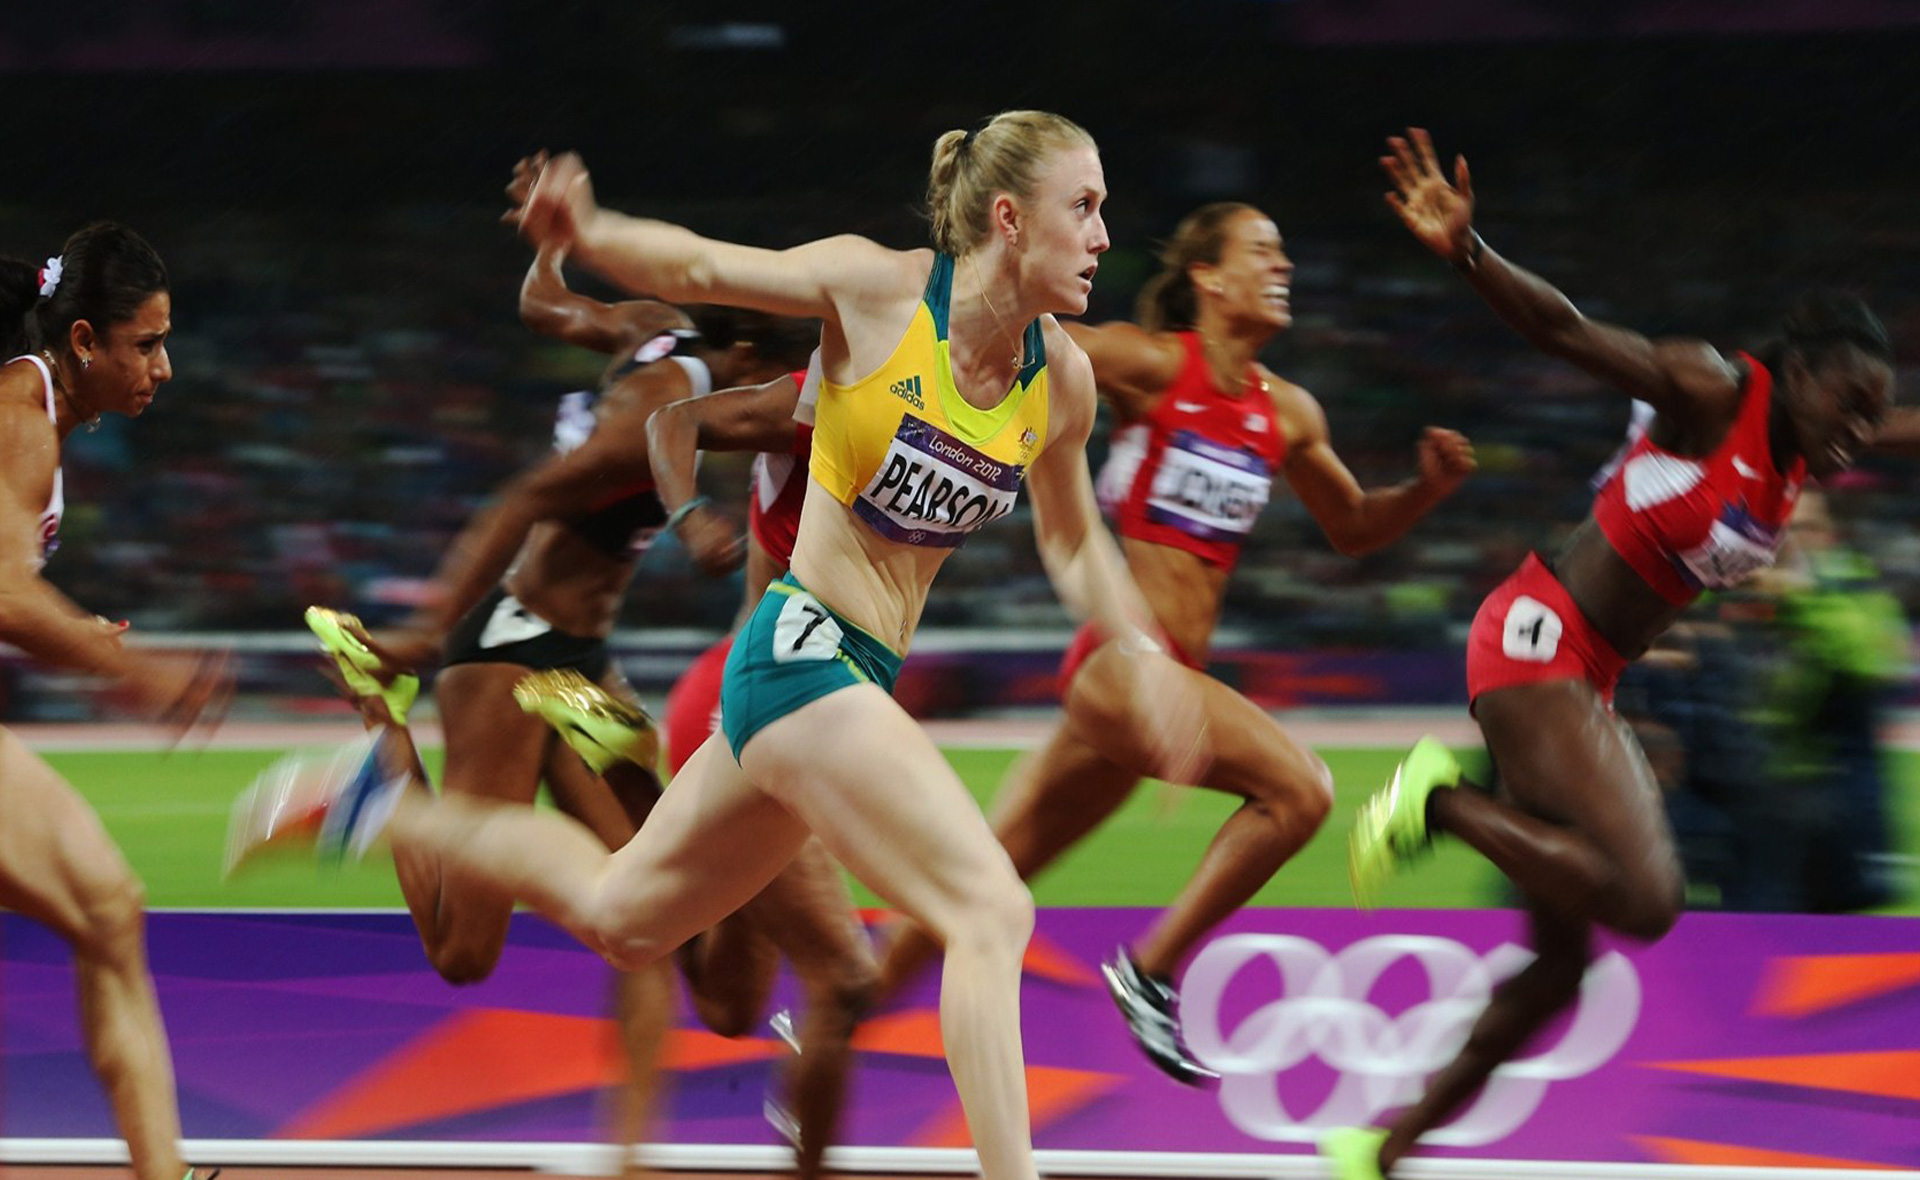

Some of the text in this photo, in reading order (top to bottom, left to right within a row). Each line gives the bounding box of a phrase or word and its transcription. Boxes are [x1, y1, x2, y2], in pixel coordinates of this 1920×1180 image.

[890, 383, 925, 411] adidas
[929, 435, 1002, 482] London 2012
[870, 453, 1010, 527] PEARSON
[792, 604, 829, 651] 7
